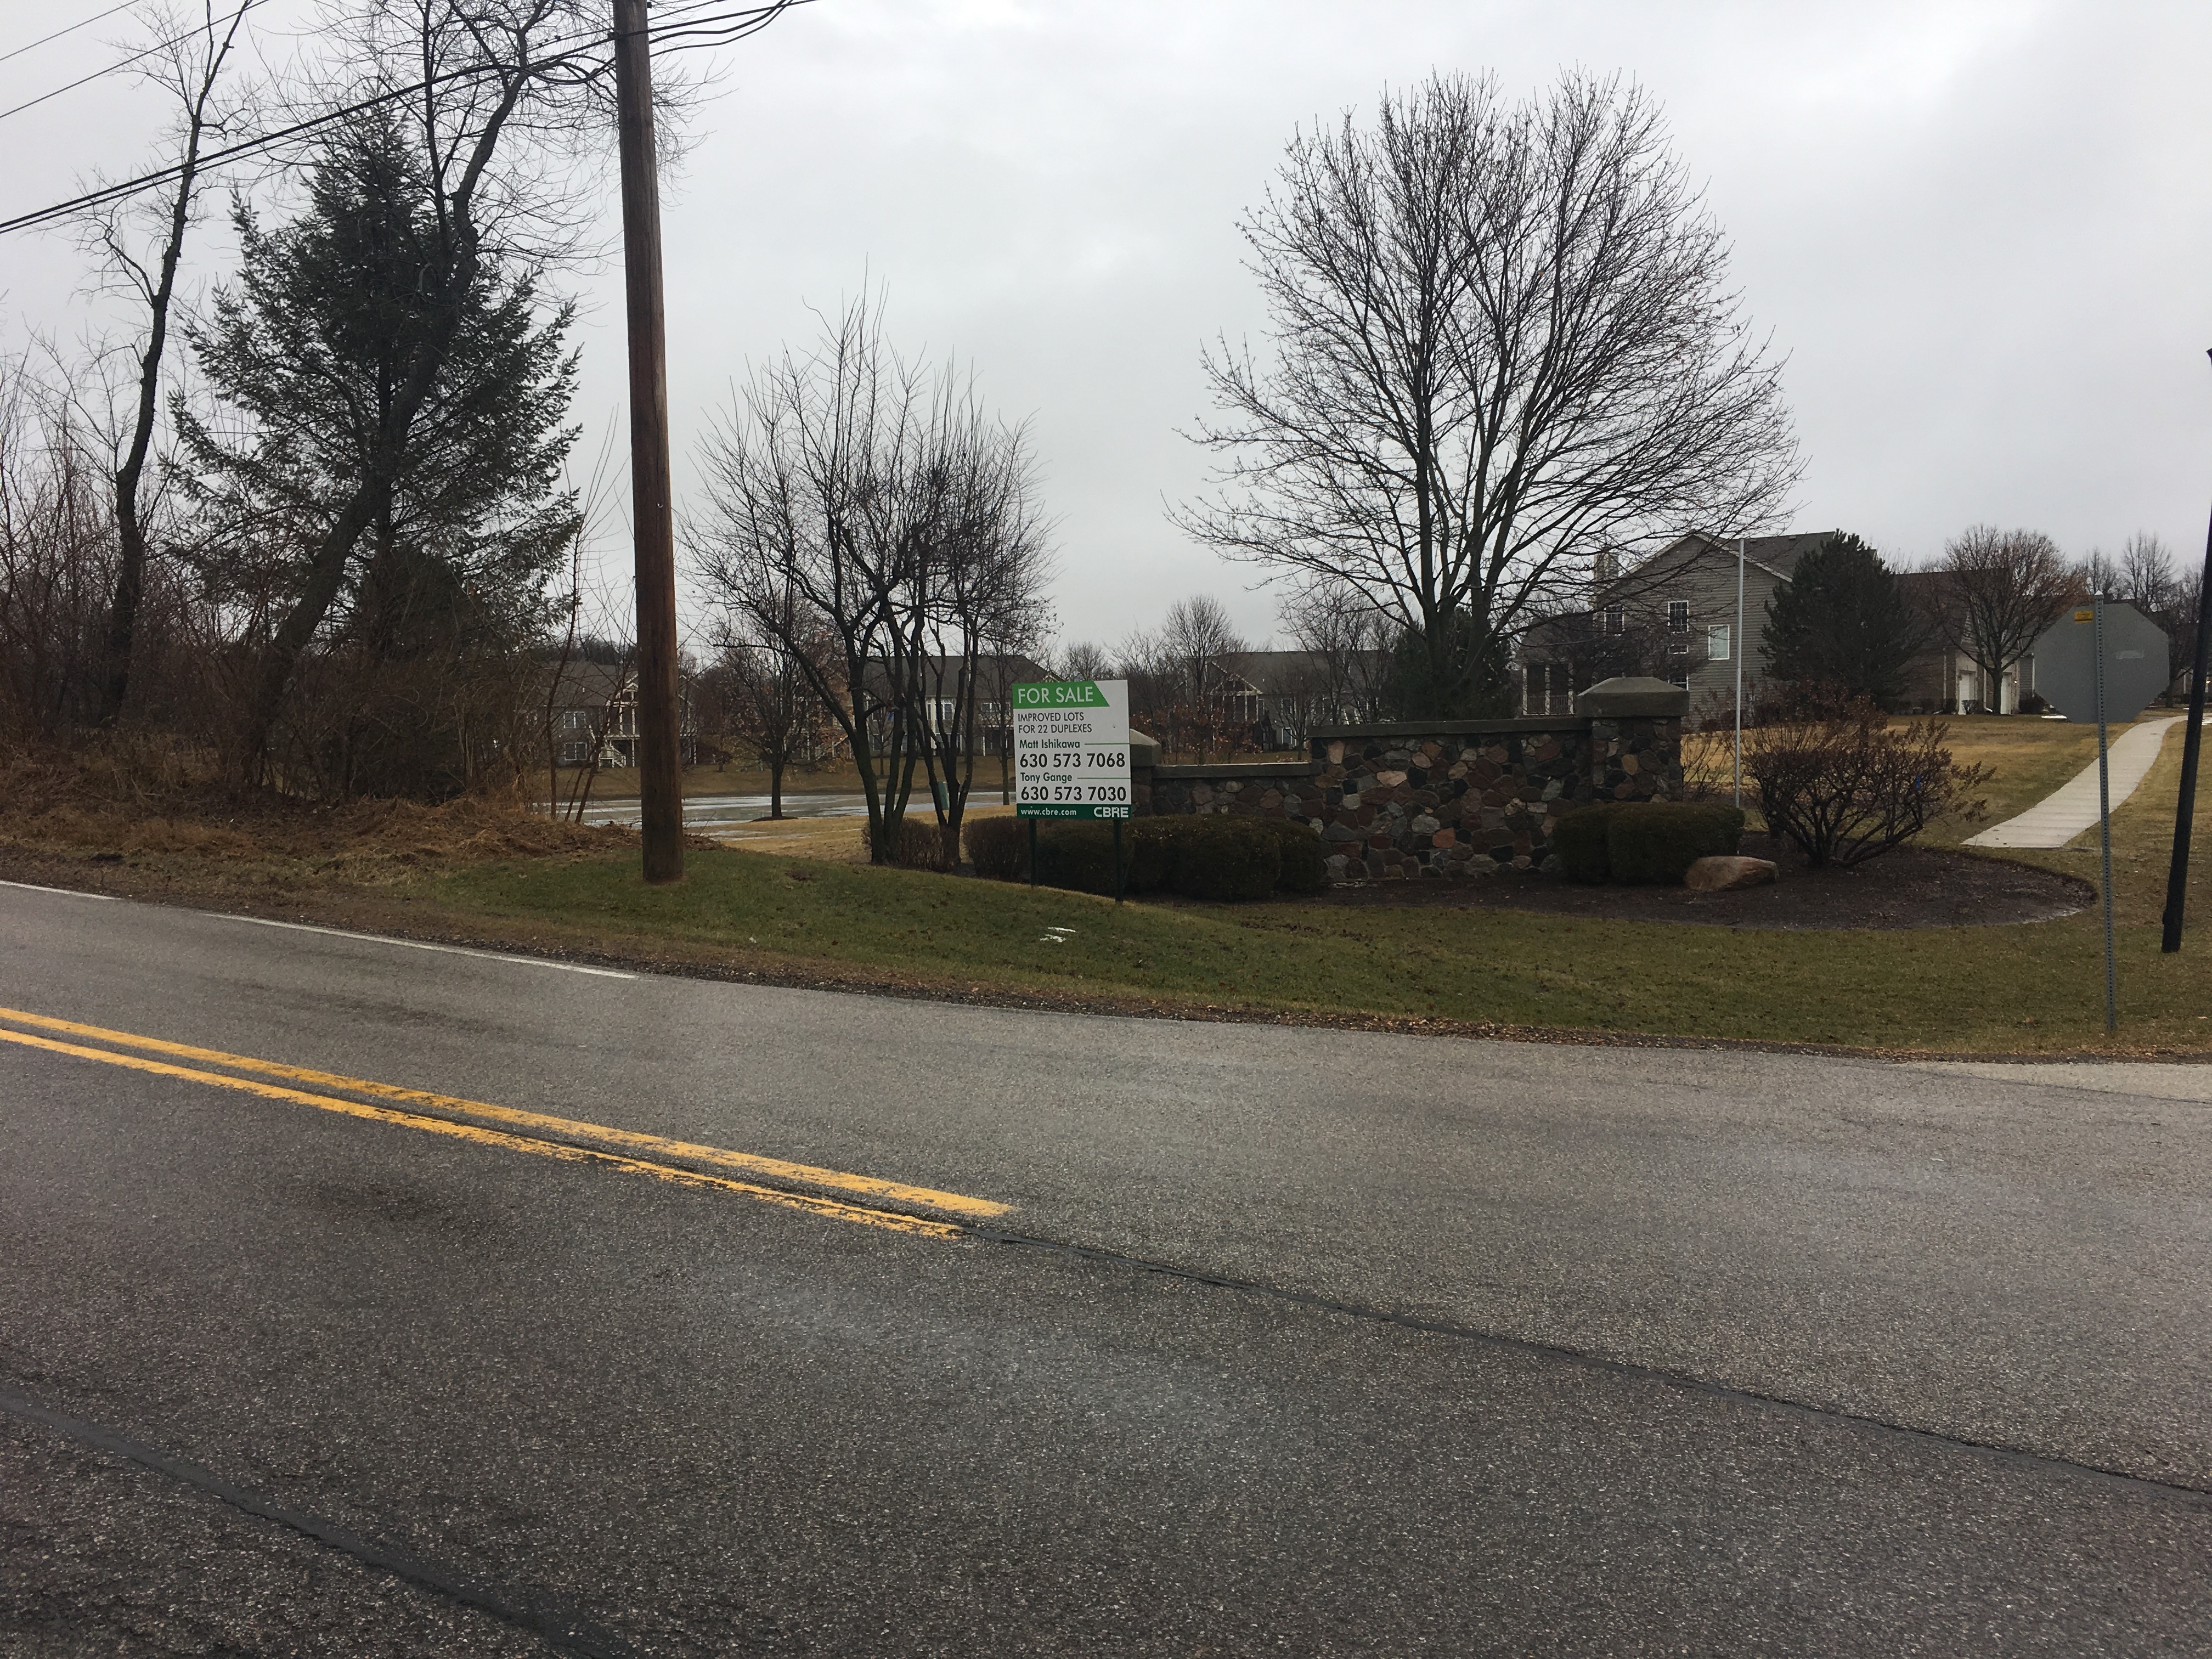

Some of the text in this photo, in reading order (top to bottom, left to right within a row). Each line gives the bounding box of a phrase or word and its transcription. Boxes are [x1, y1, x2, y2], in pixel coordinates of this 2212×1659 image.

[1018, 686, 1093, 703] FOR SALE
[1018, 712, 1084, 722] IMPROVED LOTS
[1018, 724, 1092, 733] FOR 22 DUPLEXES
[1019, 739, 1080, 749] Matt Ishikawa
[1020, 753, 1125, 768] 630 573 7068
[1020, 772, 1072, 783] Tony Gange
[1021, 786, 1126, 801] 630 573 7030
[1020, 808, 1077, 816] www.cbre.com
[1093, 807, 1128, 818] CBRE
